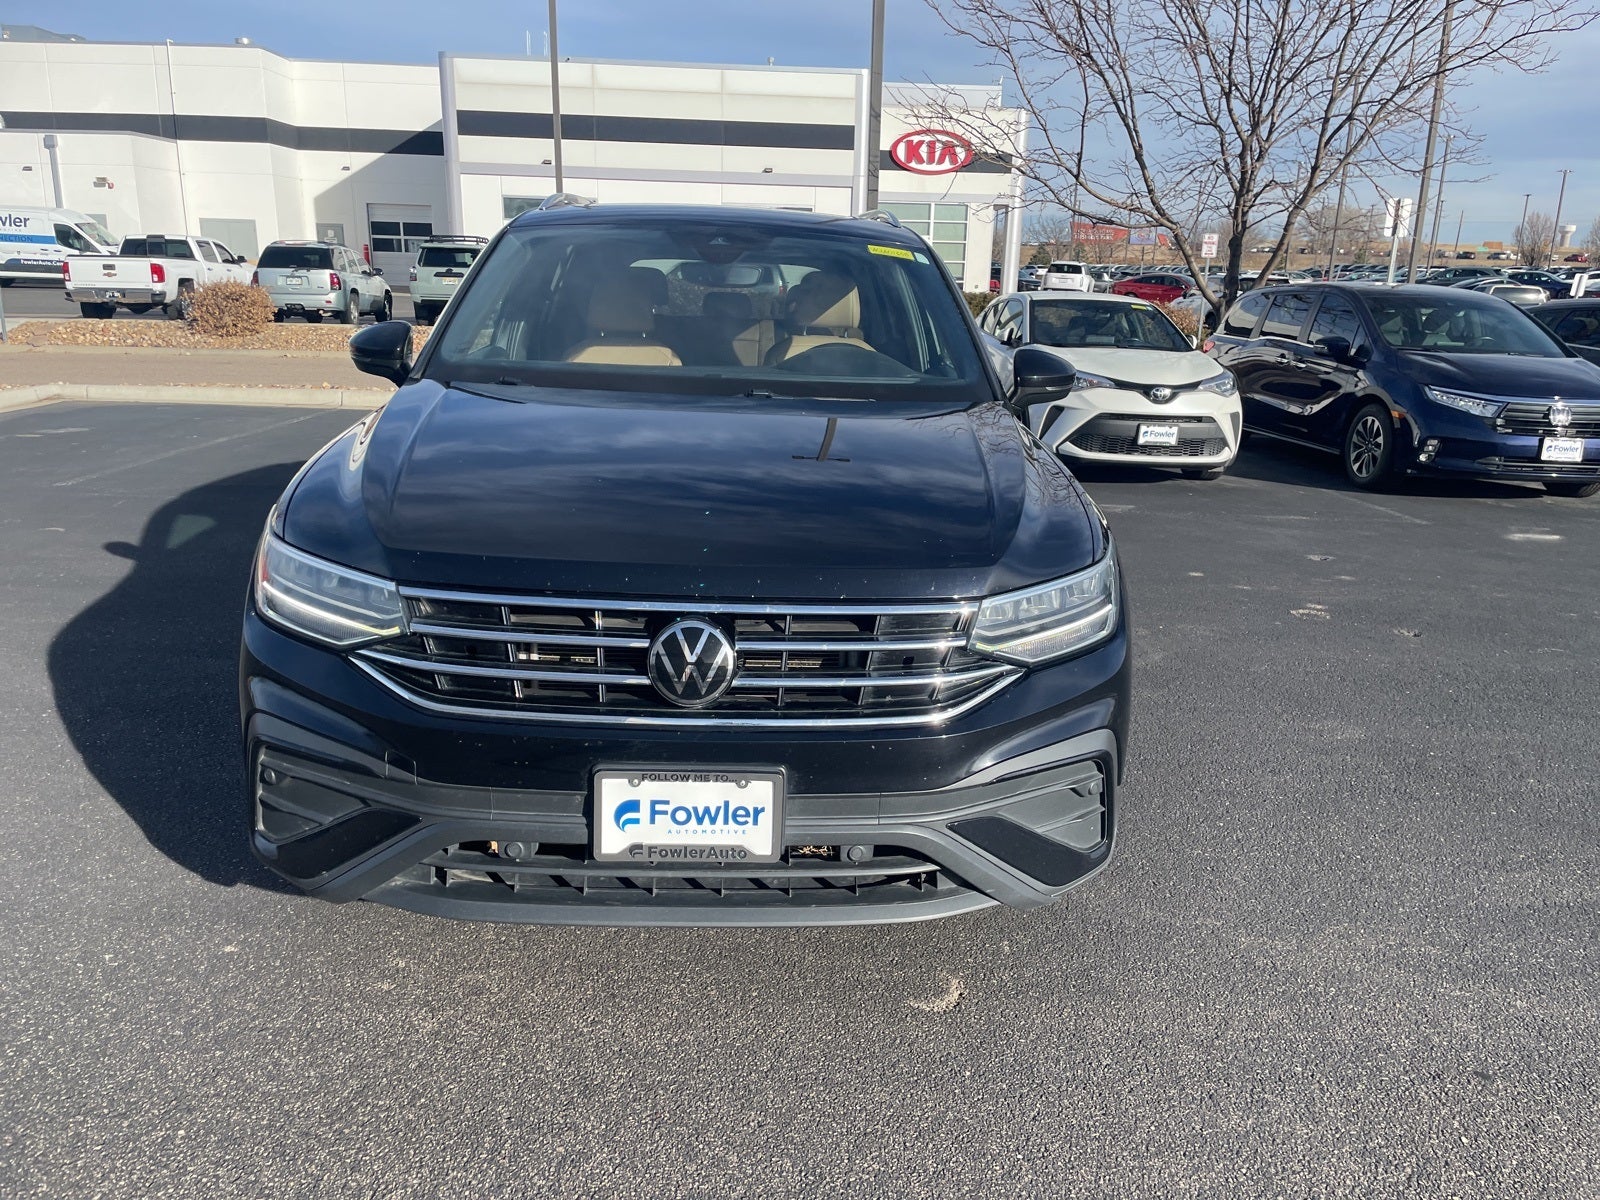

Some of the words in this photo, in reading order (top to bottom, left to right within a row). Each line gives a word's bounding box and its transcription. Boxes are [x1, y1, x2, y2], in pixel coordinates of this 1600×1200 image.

[904, 139, 959, 165] KIA
[1149, 430, 1176, 438] Fowler
[1553, 445, 1580, 453] Fowler
[641, 773, 690, 783] FOLLOW
[694, 773, 710, 783] ME
[649, 800, 766, 826] Fowler
[647, 845, 748, 860] FowlerAuto
